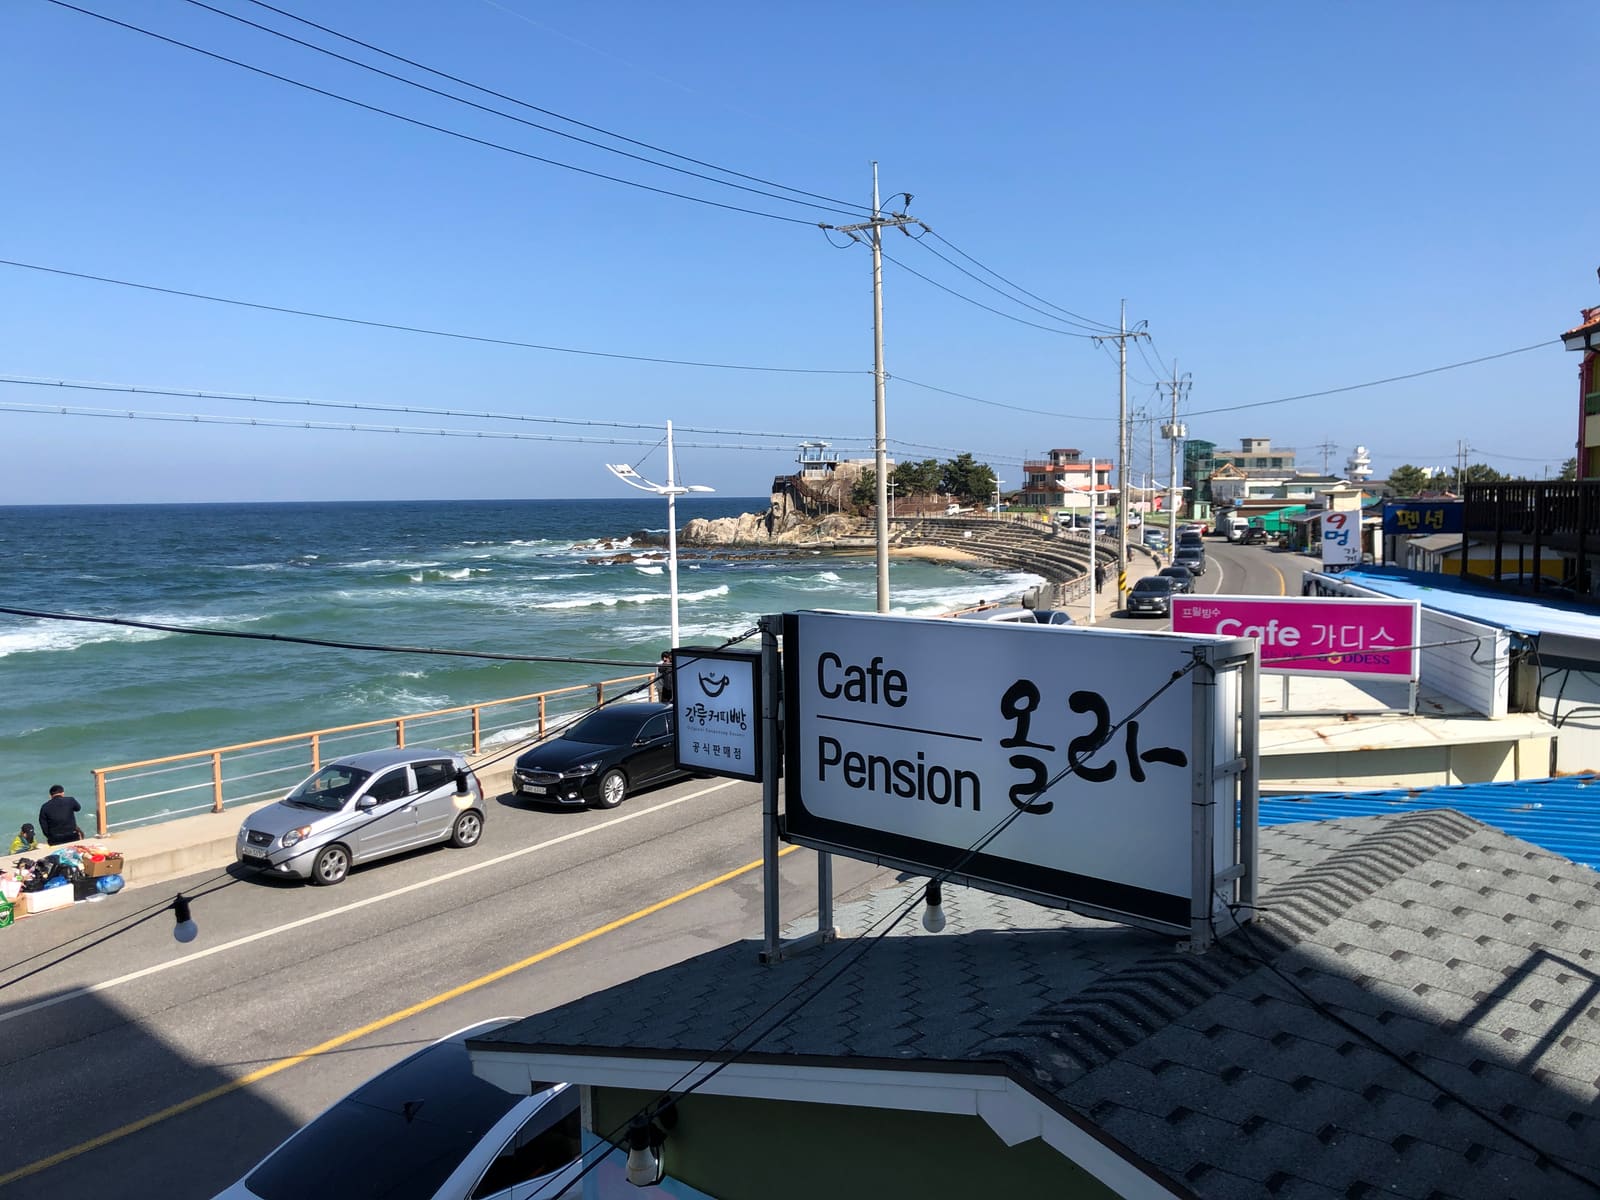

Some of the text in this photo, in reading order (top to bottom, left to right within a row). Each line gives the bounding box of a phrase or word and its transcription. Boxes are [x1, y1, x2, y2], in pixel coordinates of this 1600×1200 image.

[1396, 508, 1445, 530] 펜션
[1310, 624, 1397, 650] 가디스
[817, 651, 908, 708] Cafe
[685, 703, 747, 730] 강릉커피빵
[692, 741, 742, 760] 공식판매점
[1000, 679, 1188, 815] 올라
[818, 735, 981, 812] Pension
